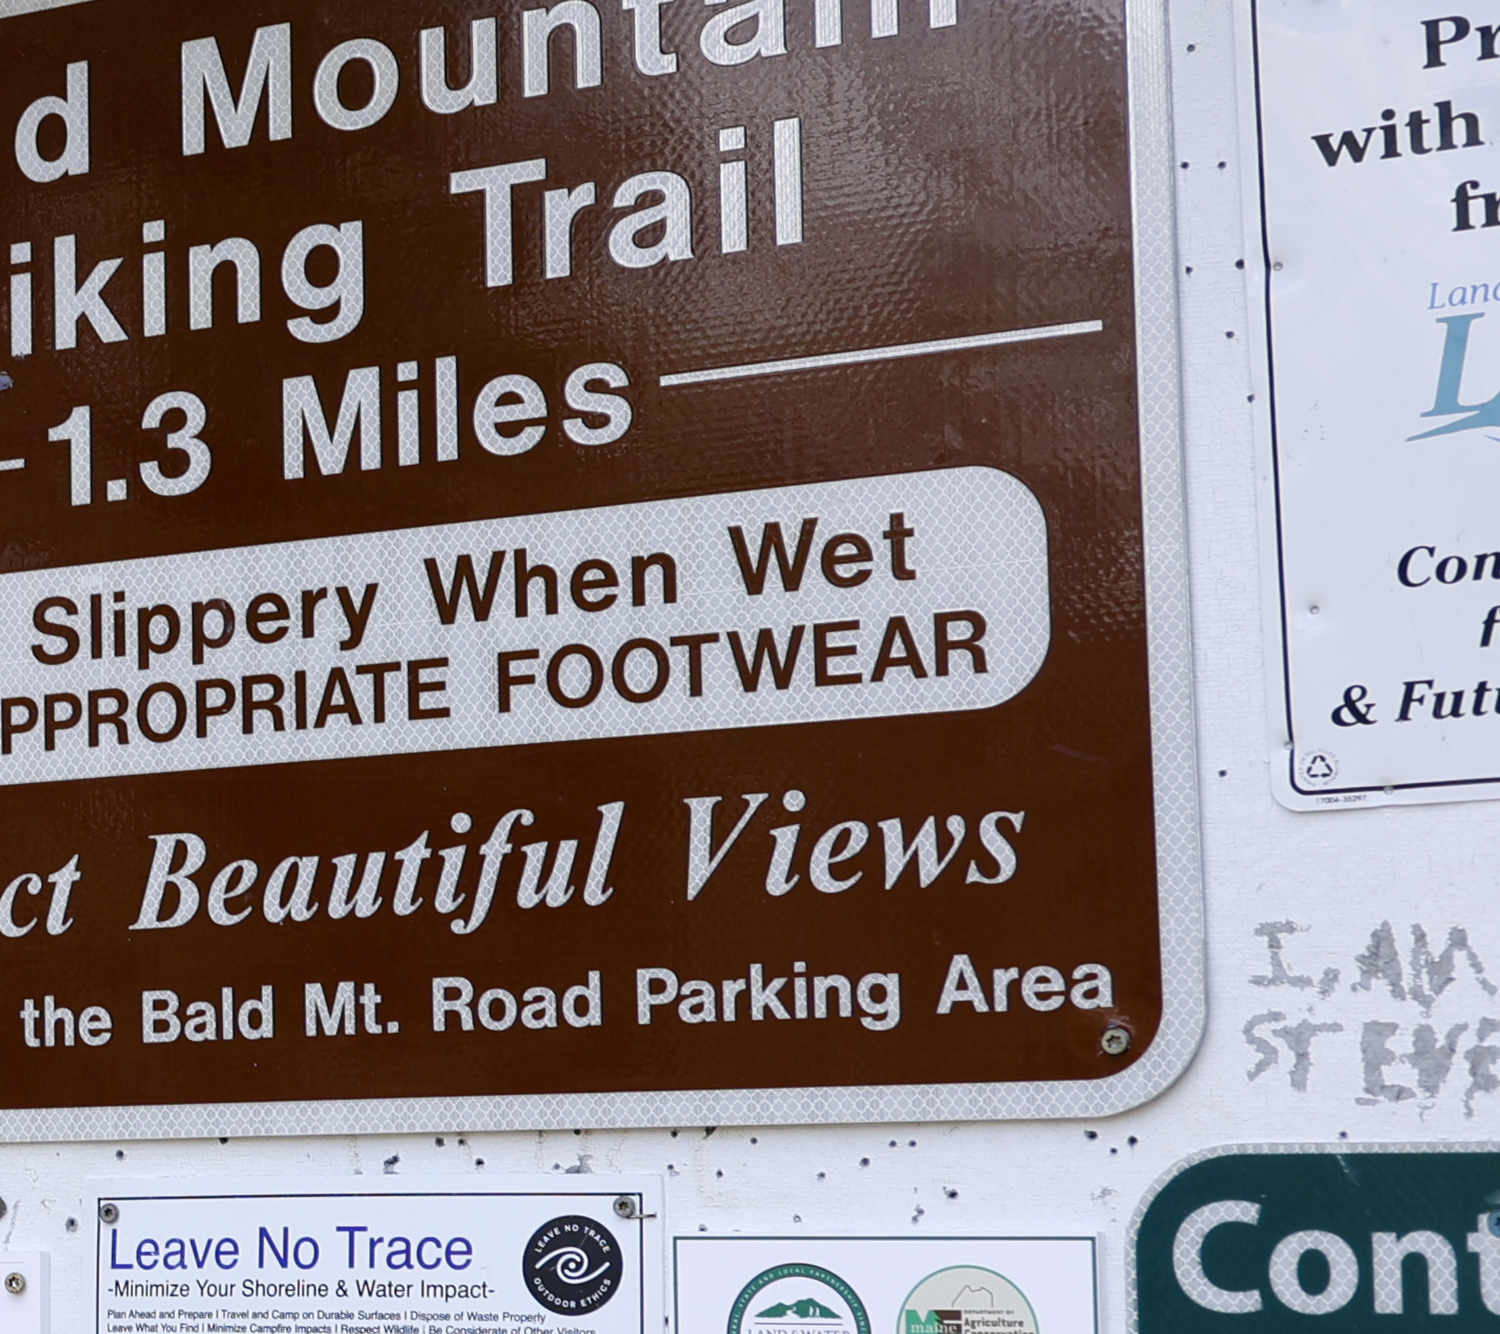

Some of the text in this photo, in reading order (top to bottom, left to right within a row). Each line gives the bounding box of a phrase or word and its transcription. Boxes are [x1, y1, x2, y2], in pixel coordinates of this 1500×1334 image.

[1311, 100, 1484, 167] with
[450, 117, 802, 287] Trail
[48, 356, 631, 506] 1.3 Miles
[31, 583, 379, 670] Slippery
[423, 548, 677, 625] When
[727, 512, 916, 596] Wet
[497, 610, 988, 713] FOOTWEAR
[129, 801, 624, 934] Beautiful
[684, 790, 1024, 900] Views
[20, 996, 111, 1047] the
[142, 985, 273, 1043] Bald
[305, 982, 398, 1036] Mt.
[433, 971, 601, 1031] Road
[637, 962, 900, 1030] Parking
[937, 955, 1113, 1014] Area
[111, 1226, 472, 1270] Leave No Trace
[534, 1224, 610, 1253] LEAVE NO TRACE
[196, 1280, 236, 1297] Your
[242, 1279, 328, 1297] Shoreline
[336, 1280, 348, 1297] &
[356, 1280, 413, 1298] Water
[533, 1277, 611, 1308] OUTDOOR ETHICS
[964, 1318, 1024, 1329] Agriculture
